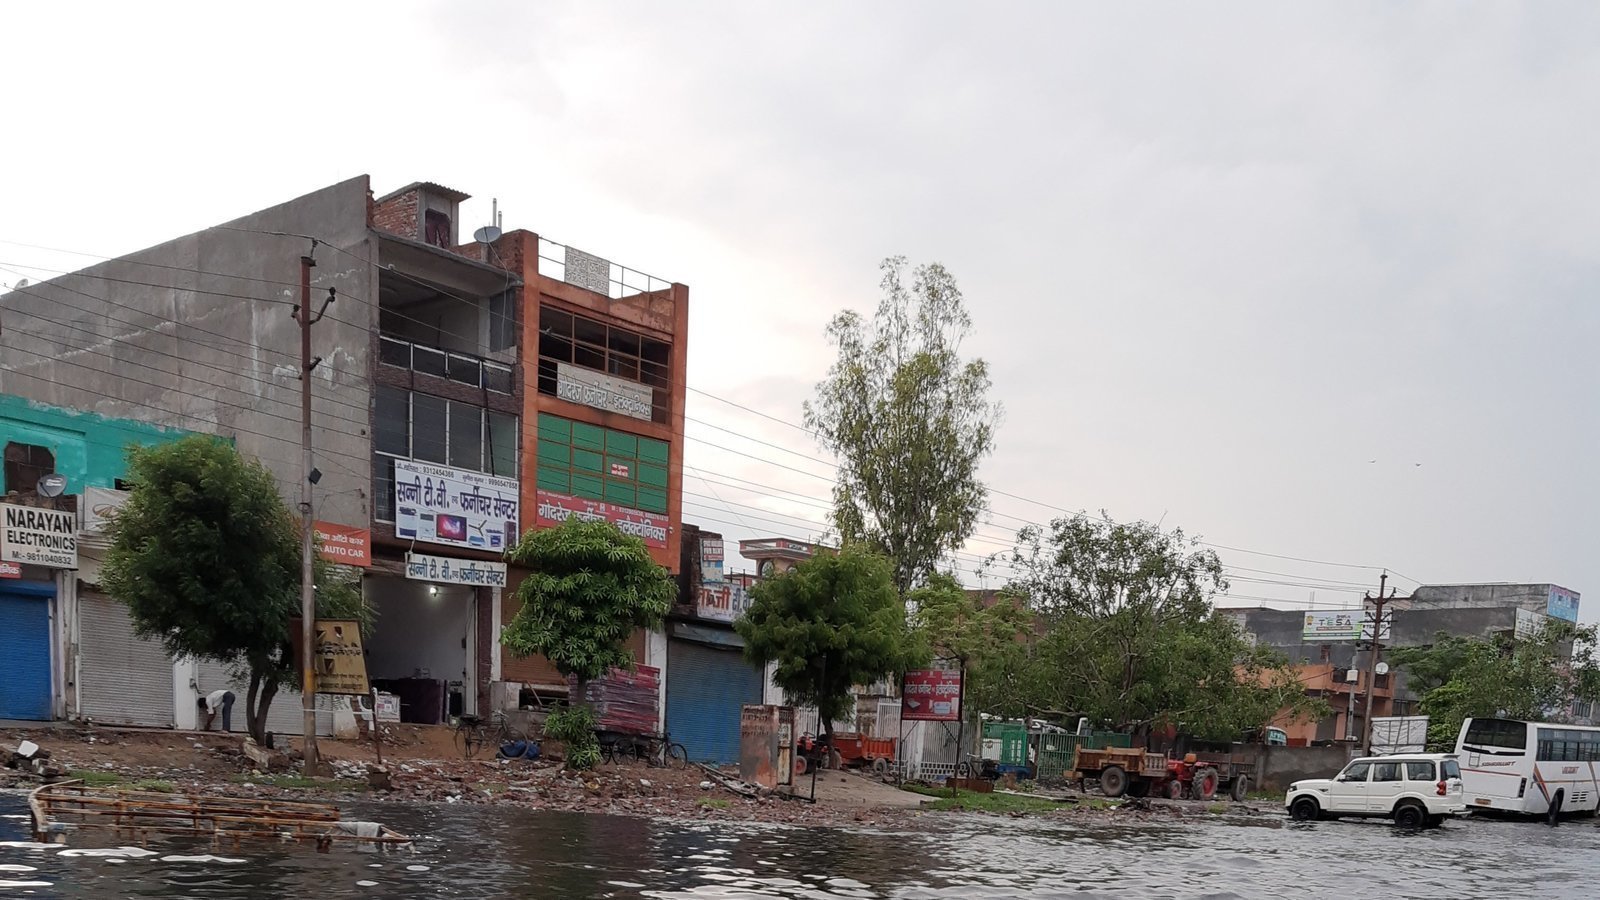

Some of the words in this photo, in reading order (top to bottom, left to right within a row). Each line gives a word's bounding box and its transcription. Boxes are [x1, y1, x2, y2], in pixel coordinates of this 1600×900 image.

[397, 475, 421, 505] सन्नी
[460, 485, 492, 516] फर्नीचर
[493, 490, 517, 520] सेन्टर
[6, 508, 72, 534] NARAYAN
[7, 530, 75, 551] ELECTRONICS
[324, 545, 346, 555] AUTO
[348, 549, 364, 558] CAR
[408, 557, 428, 577] सन्नी
[1318, 618, 1352, 626] TESA
